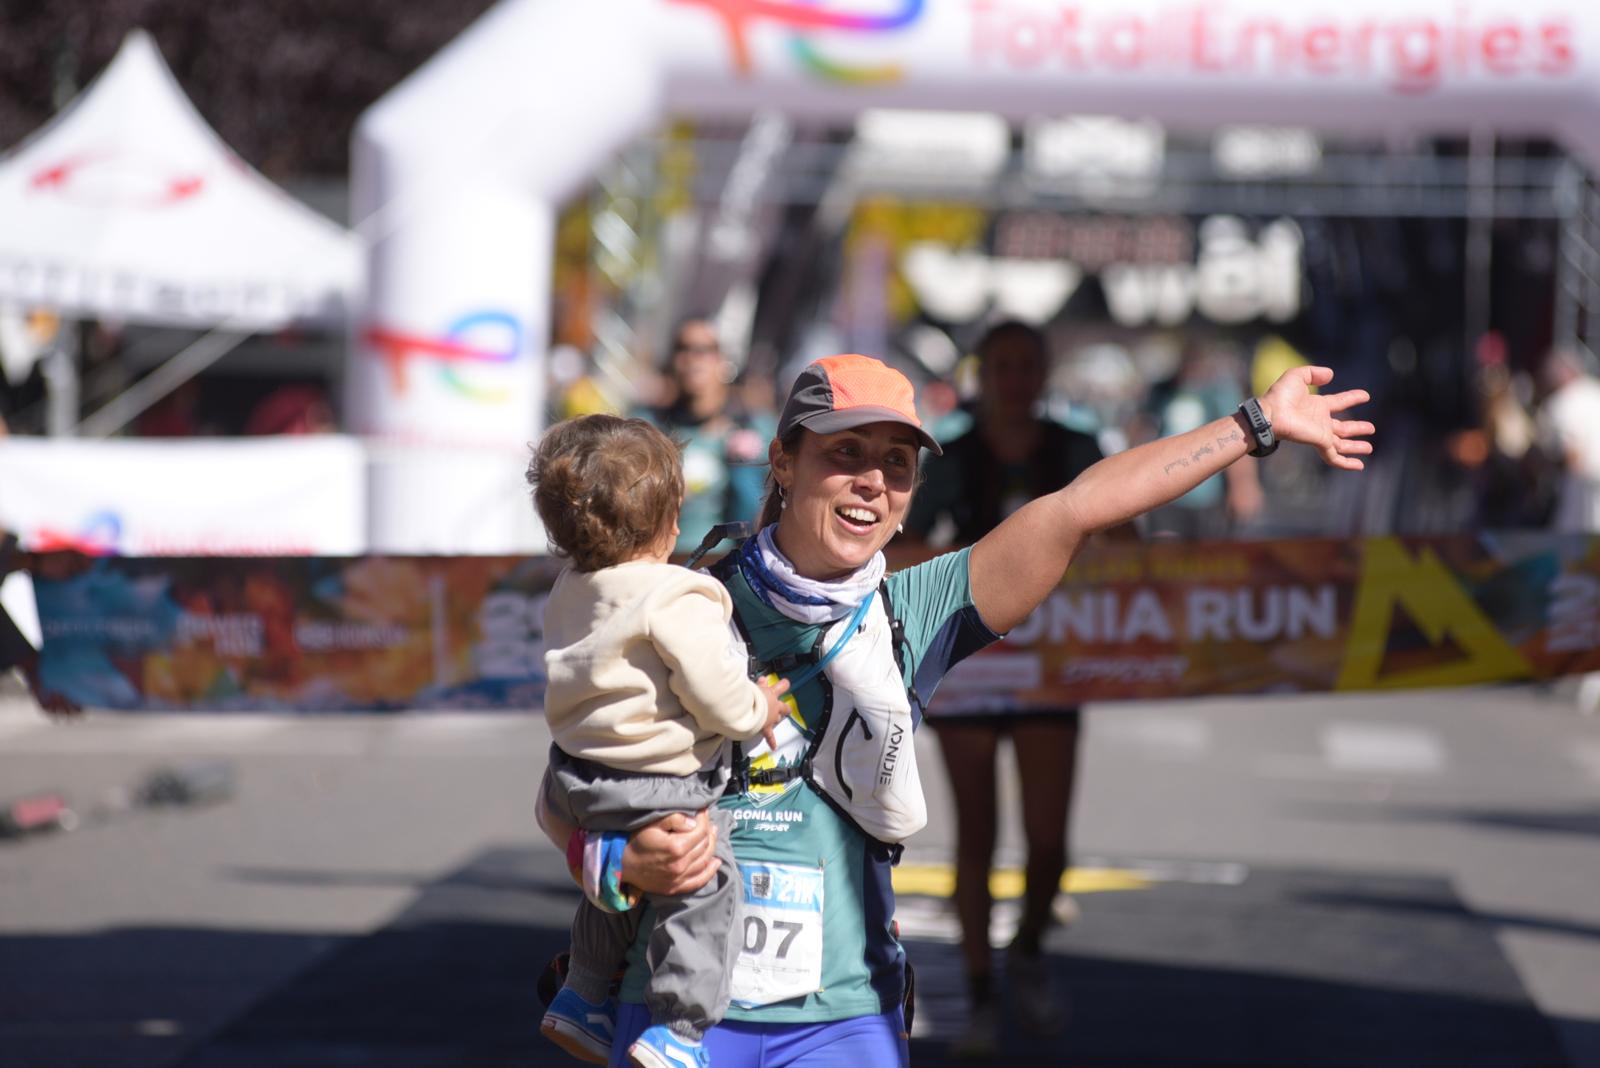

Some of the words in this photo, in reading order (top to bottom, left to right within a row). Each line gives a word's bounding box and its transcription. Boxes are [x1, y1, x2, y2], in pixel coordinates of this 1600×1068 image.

[966, 0, 1575, 95] TotalEnergies
[1185, 583, 1338, 643] RUN
[775, 809, 803, 822] RUN
